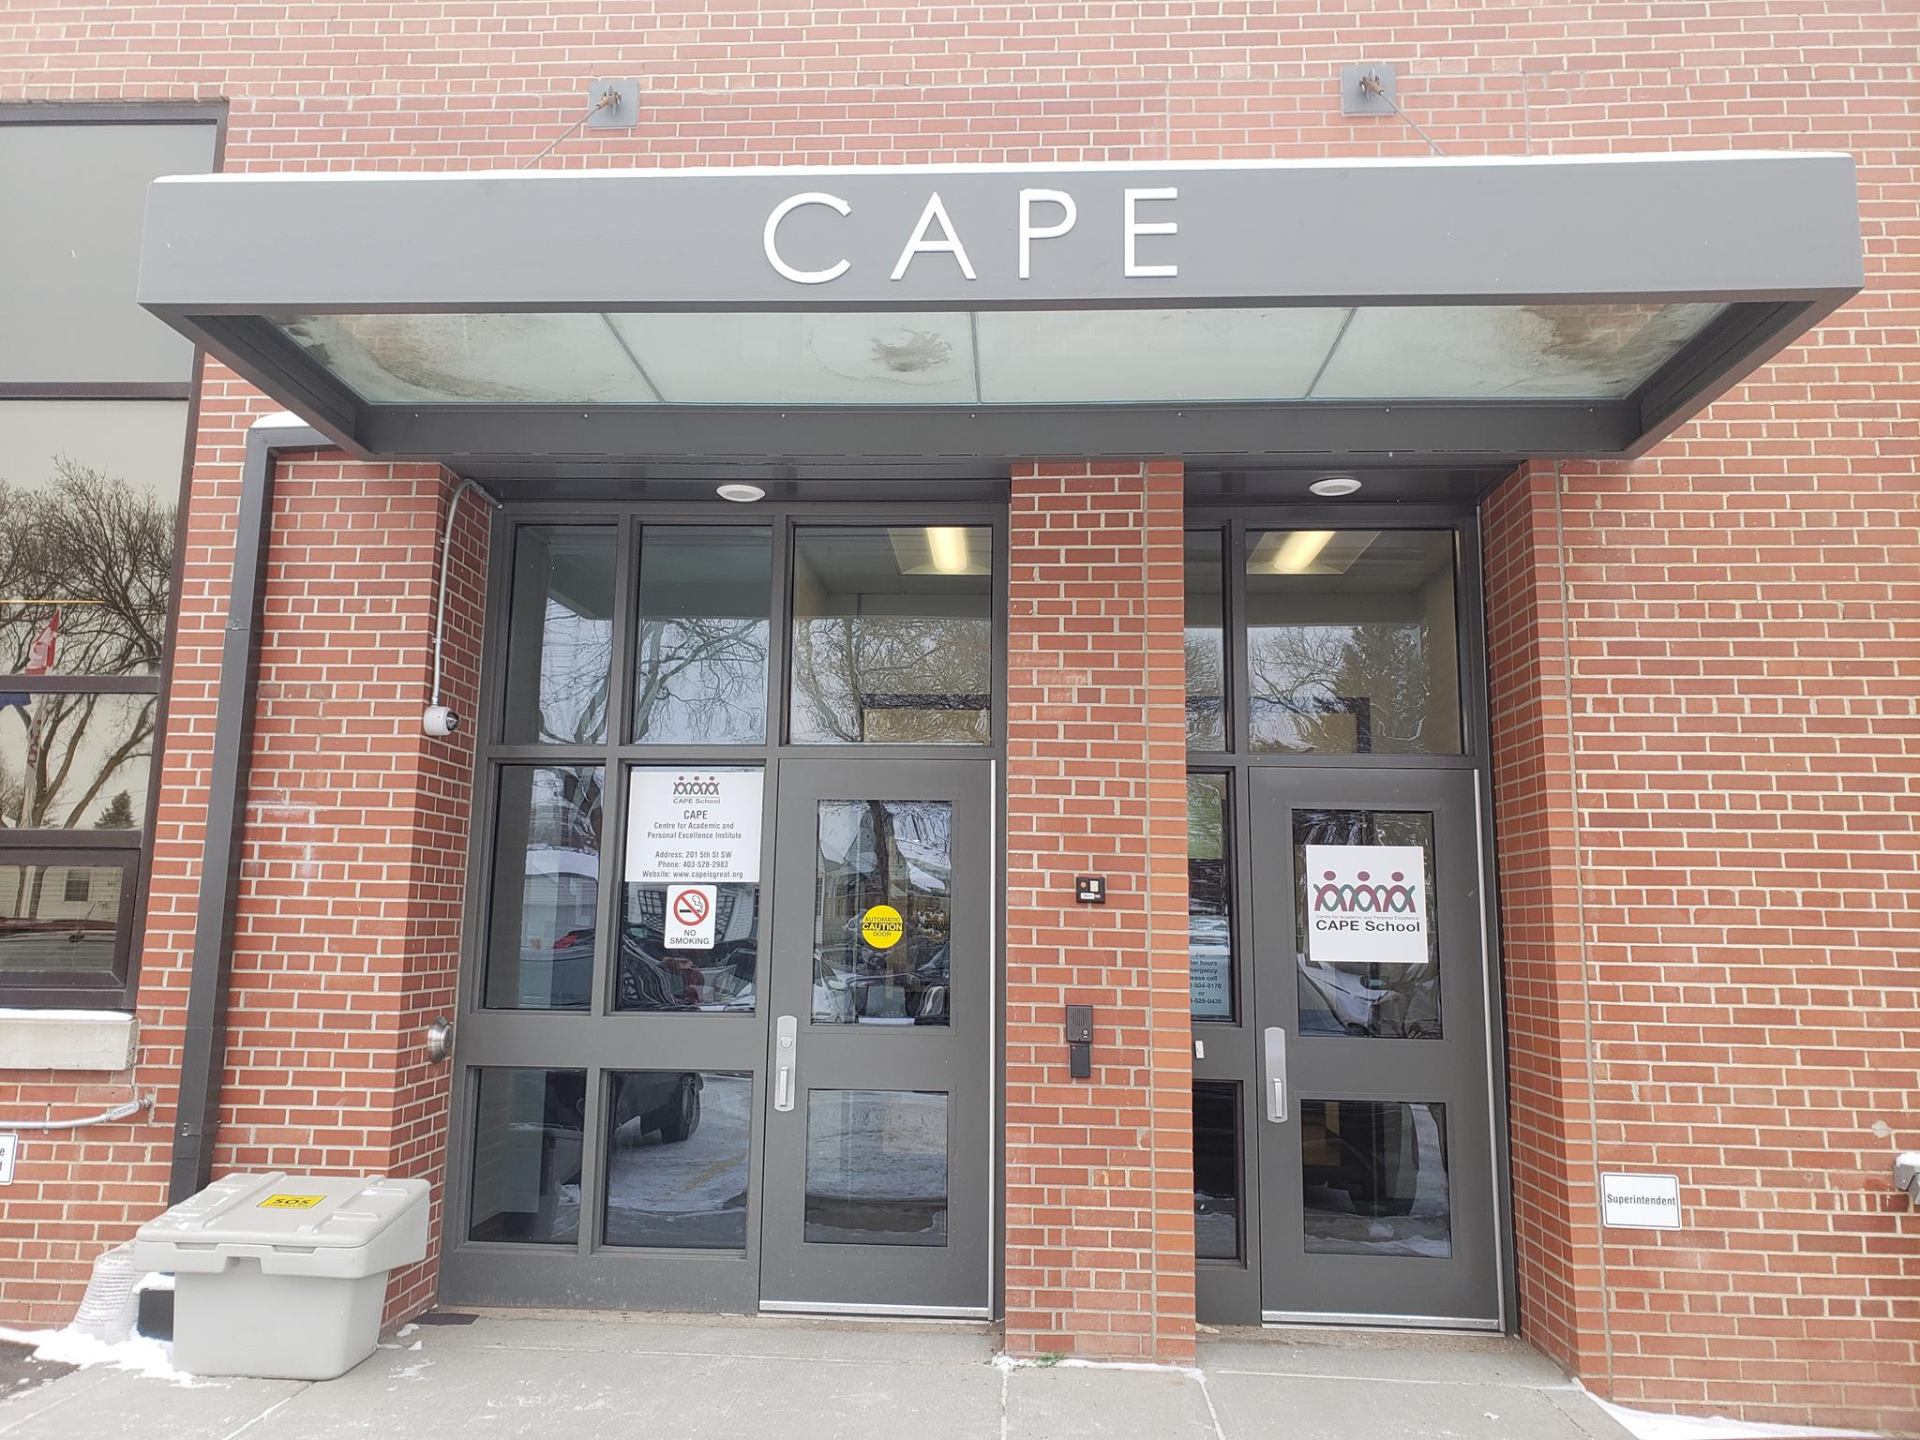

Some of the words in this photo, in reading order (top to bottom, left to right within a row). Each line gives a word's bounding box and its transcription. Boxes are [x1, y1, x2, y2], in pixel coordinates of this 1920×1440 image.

[763, 186, 1178, 285] CAPE
[683, 810, 708, 819] CAPE
[673, 871, 744, 879] www.capeisgreat.org
[1316, 919, 1359, 930] CAPE
[1365, 920, 1420, 932] School
[1607, 1193, 1676, 1206] Superintendent
